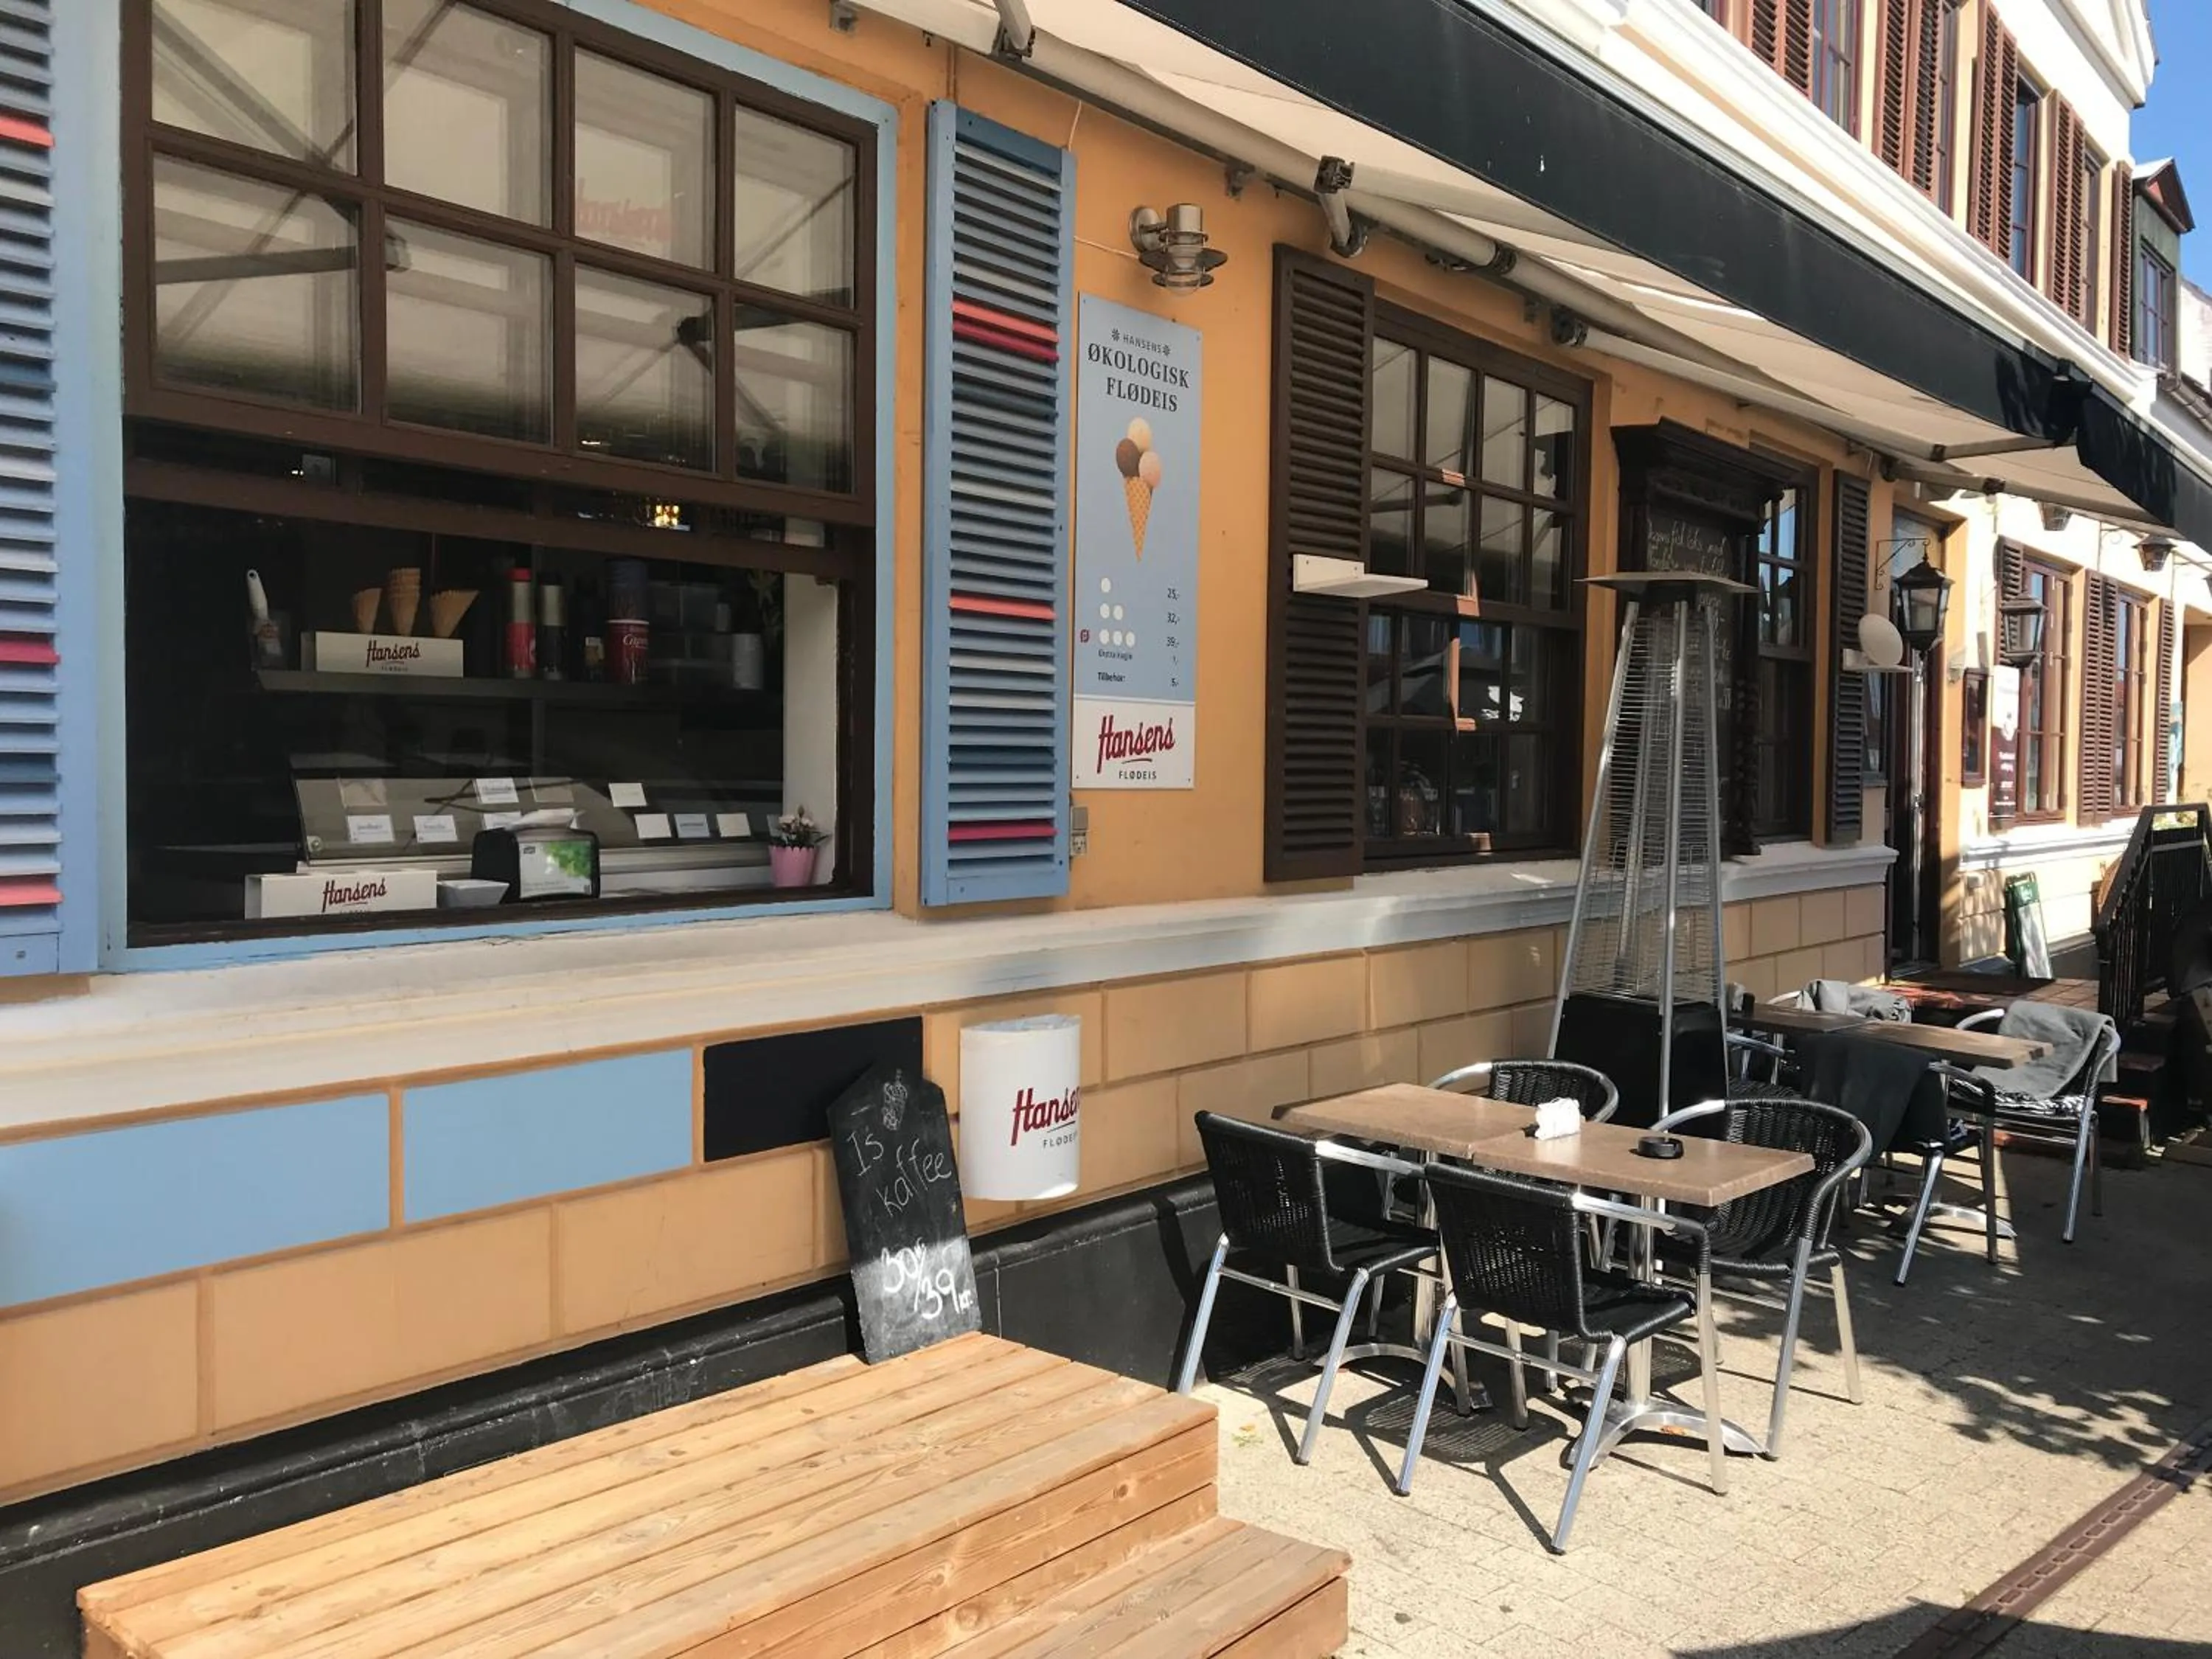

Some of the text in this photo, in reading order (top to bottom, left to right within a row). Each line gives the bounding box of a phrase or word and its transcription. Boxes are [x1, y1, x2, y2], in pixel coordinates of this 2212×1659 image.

[1123, 333, 1161, 353] HANSENS
[1088, 343, 1189, 389] ØKOLOGISK
[1107, 377, 1178, 412] FLØDEIS
[366, 639, 421, 667] Hansens
[1097, 714, 1175, 773] Hansens
[1119, 770, 1158, 779] FLØDEIS
[321, 877, 387, 913] Hansens
[847, 1131, 884, 1176] Is
